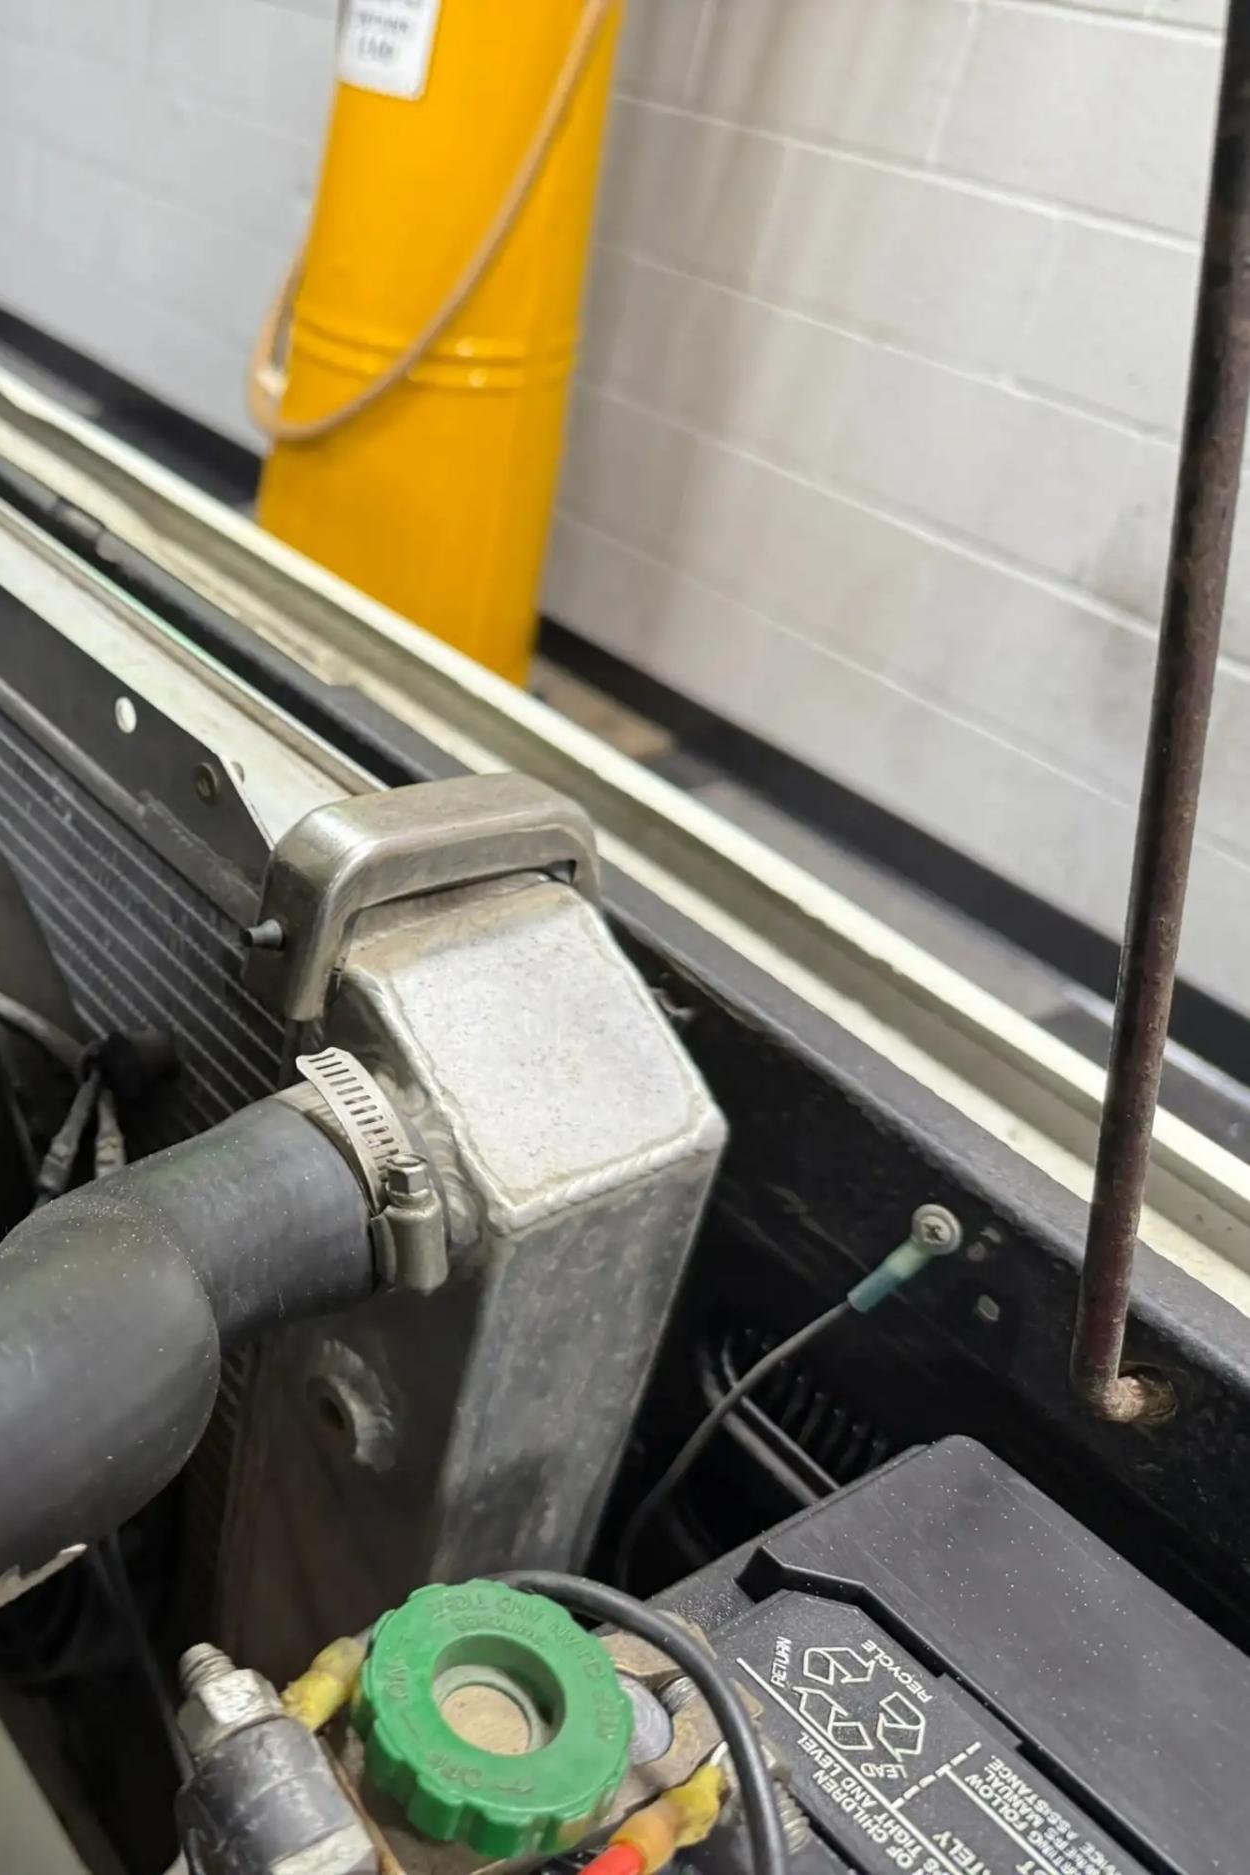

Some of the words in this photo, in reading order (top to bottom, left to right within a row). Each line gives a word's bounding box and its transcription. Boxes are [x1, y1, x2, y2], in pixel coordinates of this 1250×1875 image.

[770, 1636, 792, 1688] RETURN
[861, 1639, 933, 1703] RECYCLE
[796, 1732, 844, 1777] LEVEL
[860, 1763, 908, 1779] LEAD
[812, 1769, 889, 1844] CHILDREN
[841, 1774, 878, 1808] AND
[964, 1773, 1029, 1832] FOLLOW
[983, 1765, 1045, 1828] MANUAL.
[986, 1754, 1080, 1842] ASSISTANCE.
[873, 1811, 923, 1858] TIGHT
[886, 1844, 914, 1869] OF
[932, 1831, 990, 1875] TELY
